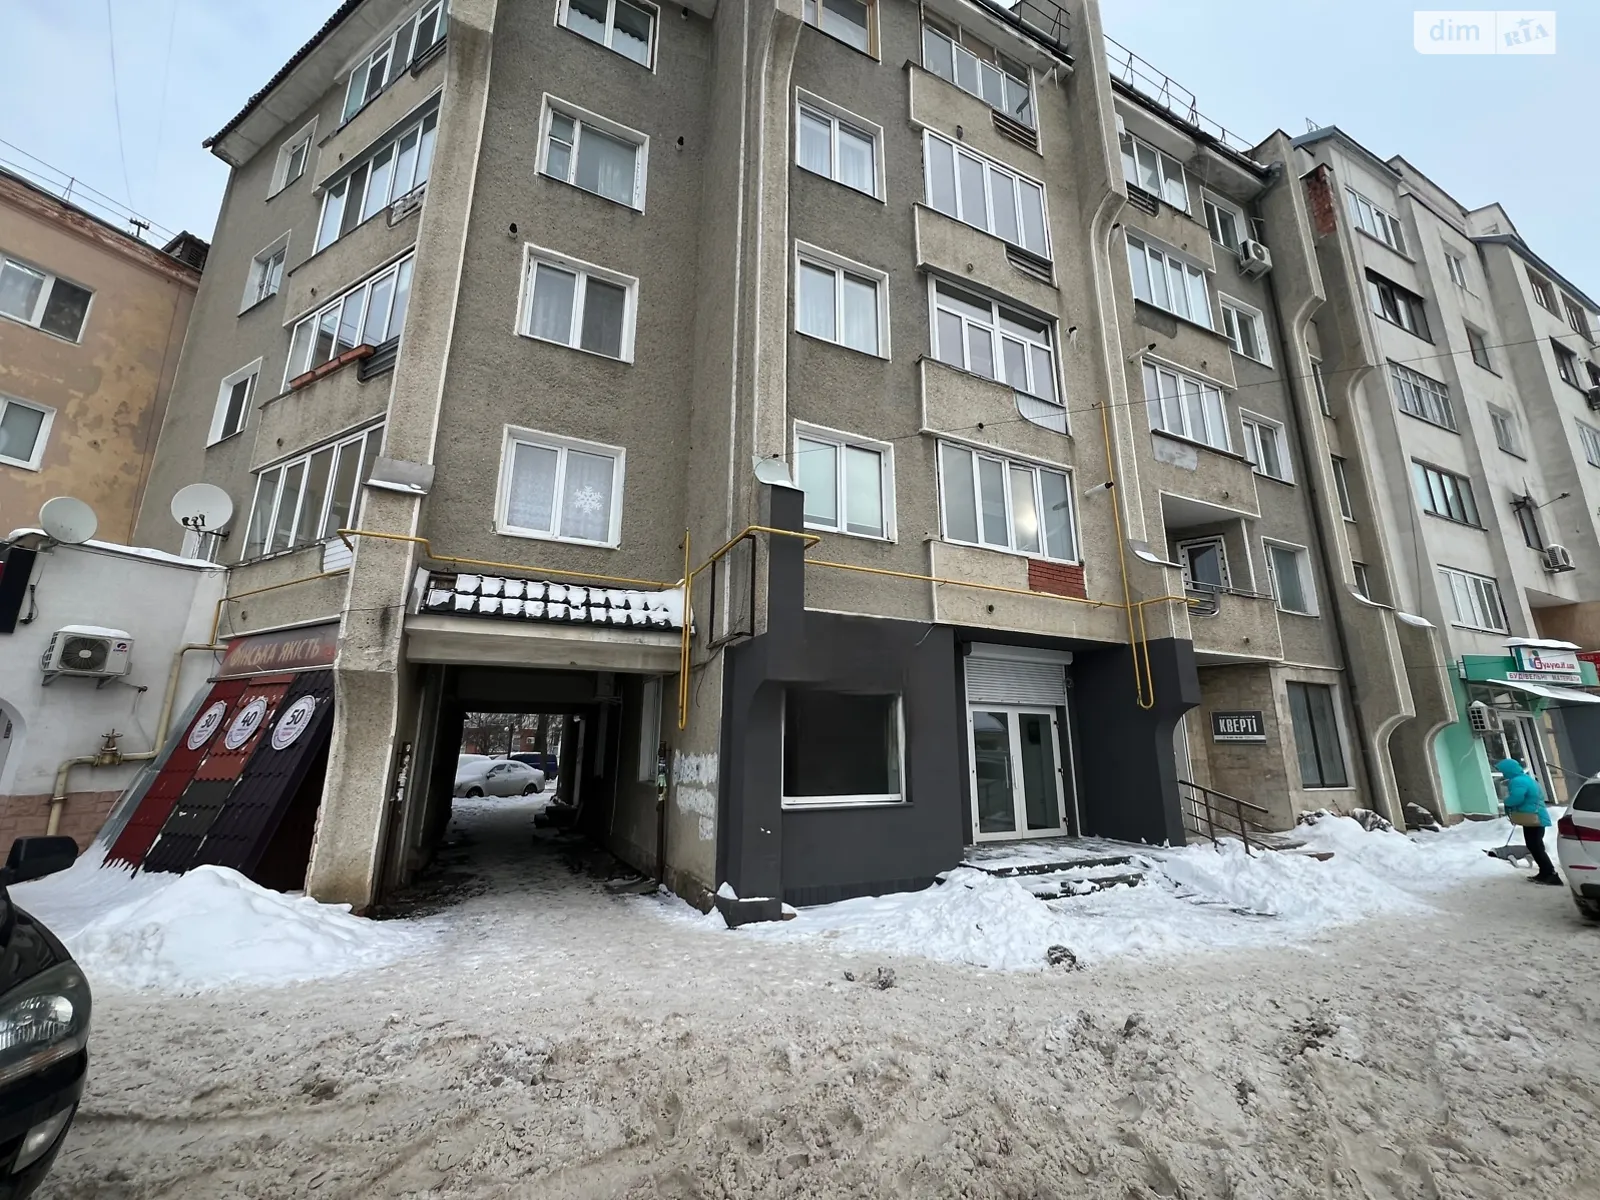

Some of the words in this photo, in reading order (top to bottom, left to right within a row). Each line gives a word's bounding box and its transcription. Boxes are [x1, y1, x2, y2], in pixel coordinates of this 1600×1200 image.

[201, 713, 217, 728] 30
[241, 711, 258, 727] 40
[286, 709, 305, 725] 50
